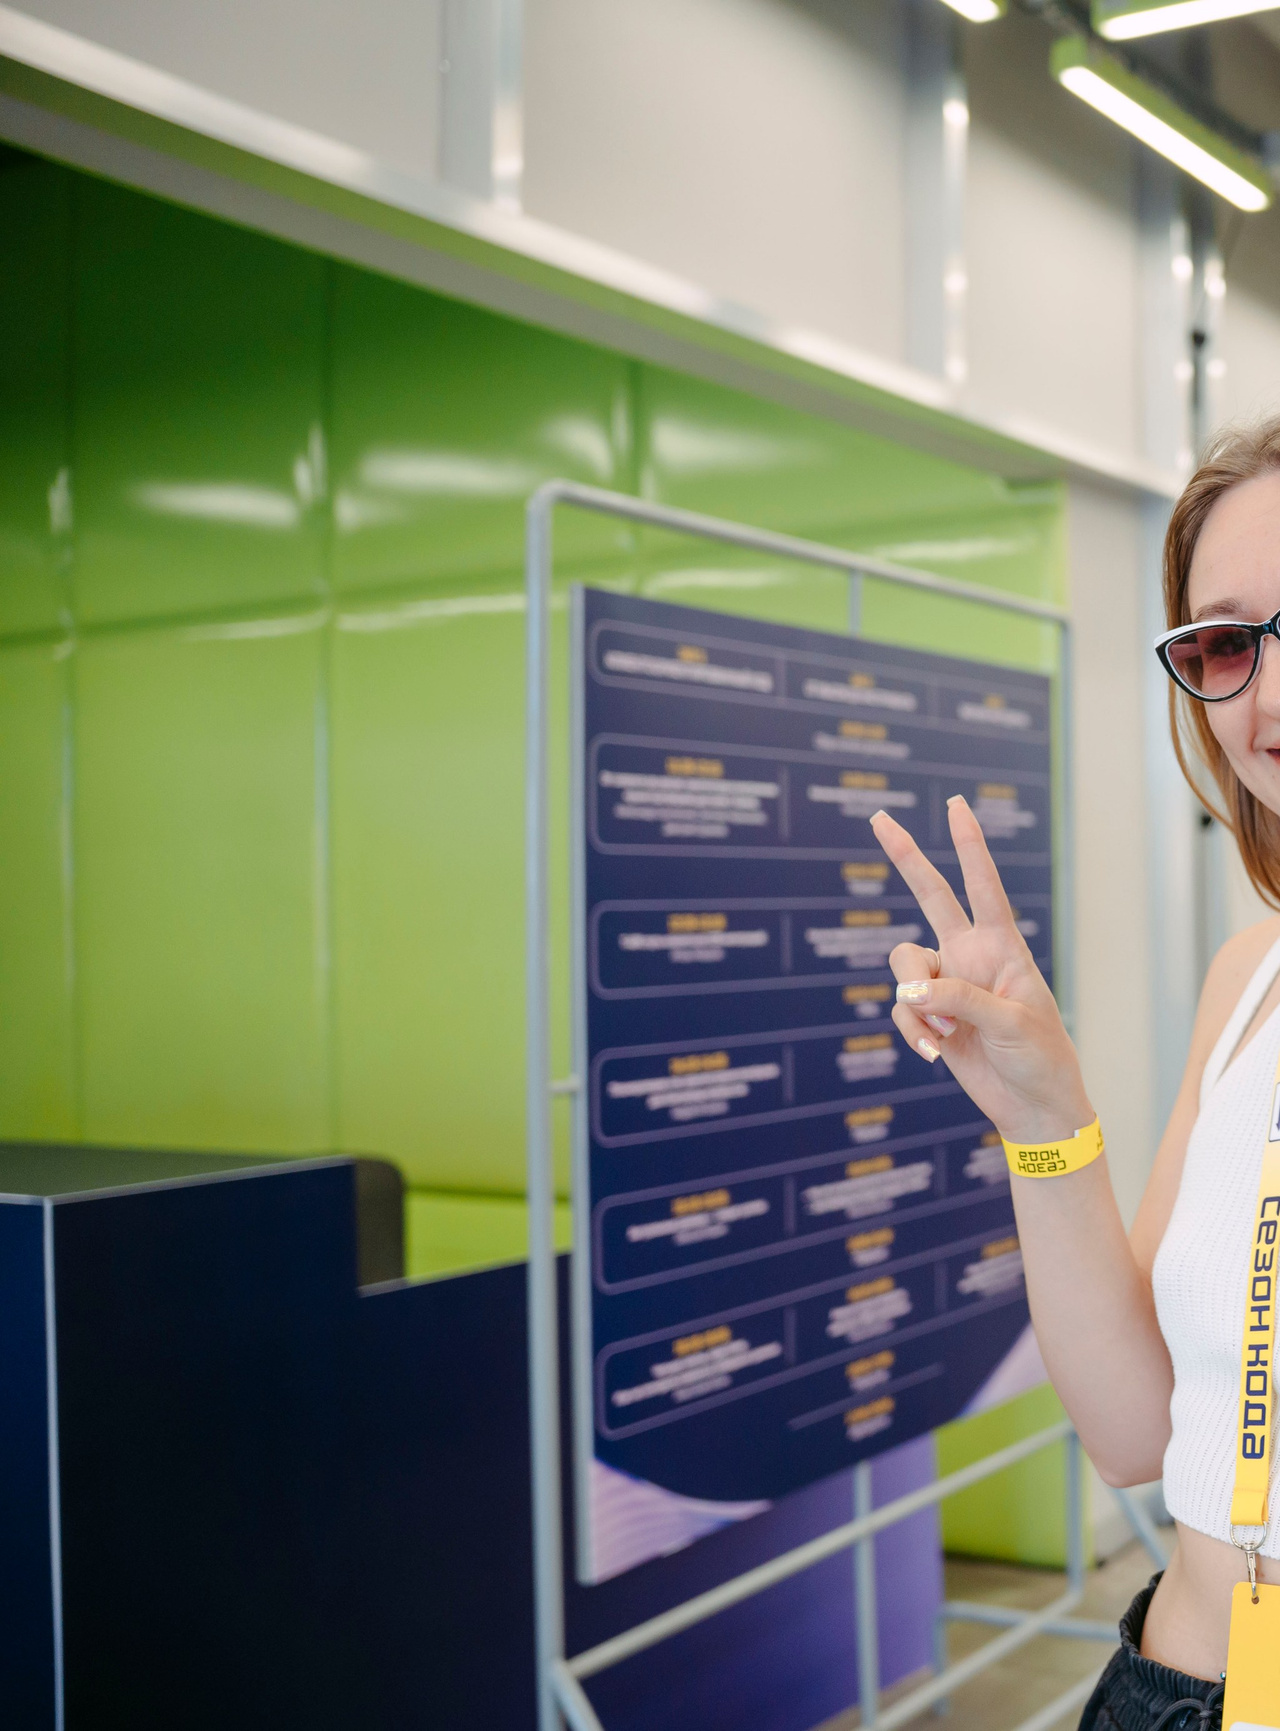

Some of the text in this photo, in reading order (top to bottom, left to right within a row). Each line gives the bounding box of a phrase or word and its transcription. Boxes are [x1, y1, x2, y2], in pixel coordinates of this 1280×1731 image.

[1018, 1149, 1061, 1162] кода
[1017, 1159, 1067, 1173] сезон
[1242, 1343, 1269, 1460] кода
